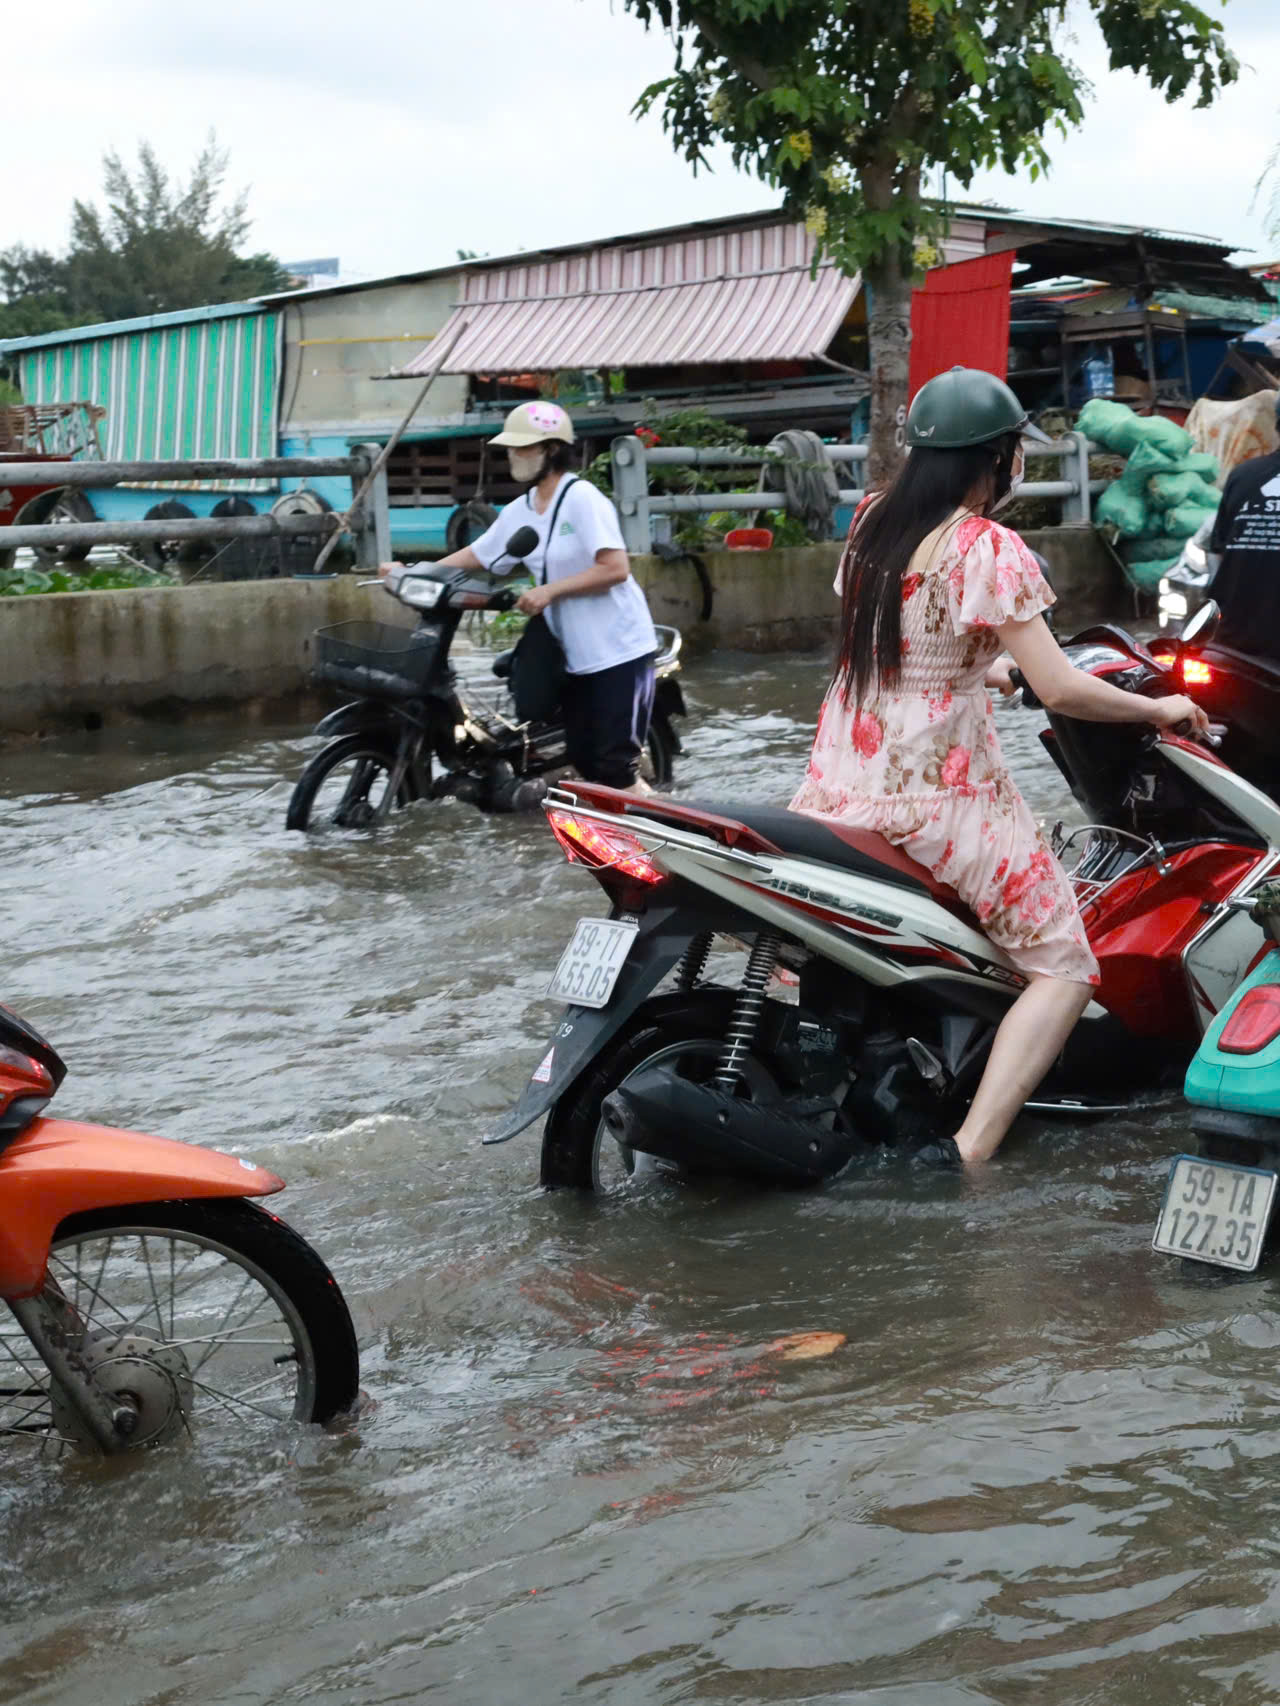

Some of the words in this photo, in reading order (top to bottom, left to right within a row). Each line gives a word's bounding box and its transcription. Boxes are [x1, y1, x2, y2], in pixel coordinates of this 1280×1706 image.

[572, 925, 625, 961] 59-T1
[1182, 1165, 1257, 1216] 59-TA
[1168, 1208, 1257, 1261] 127.35
